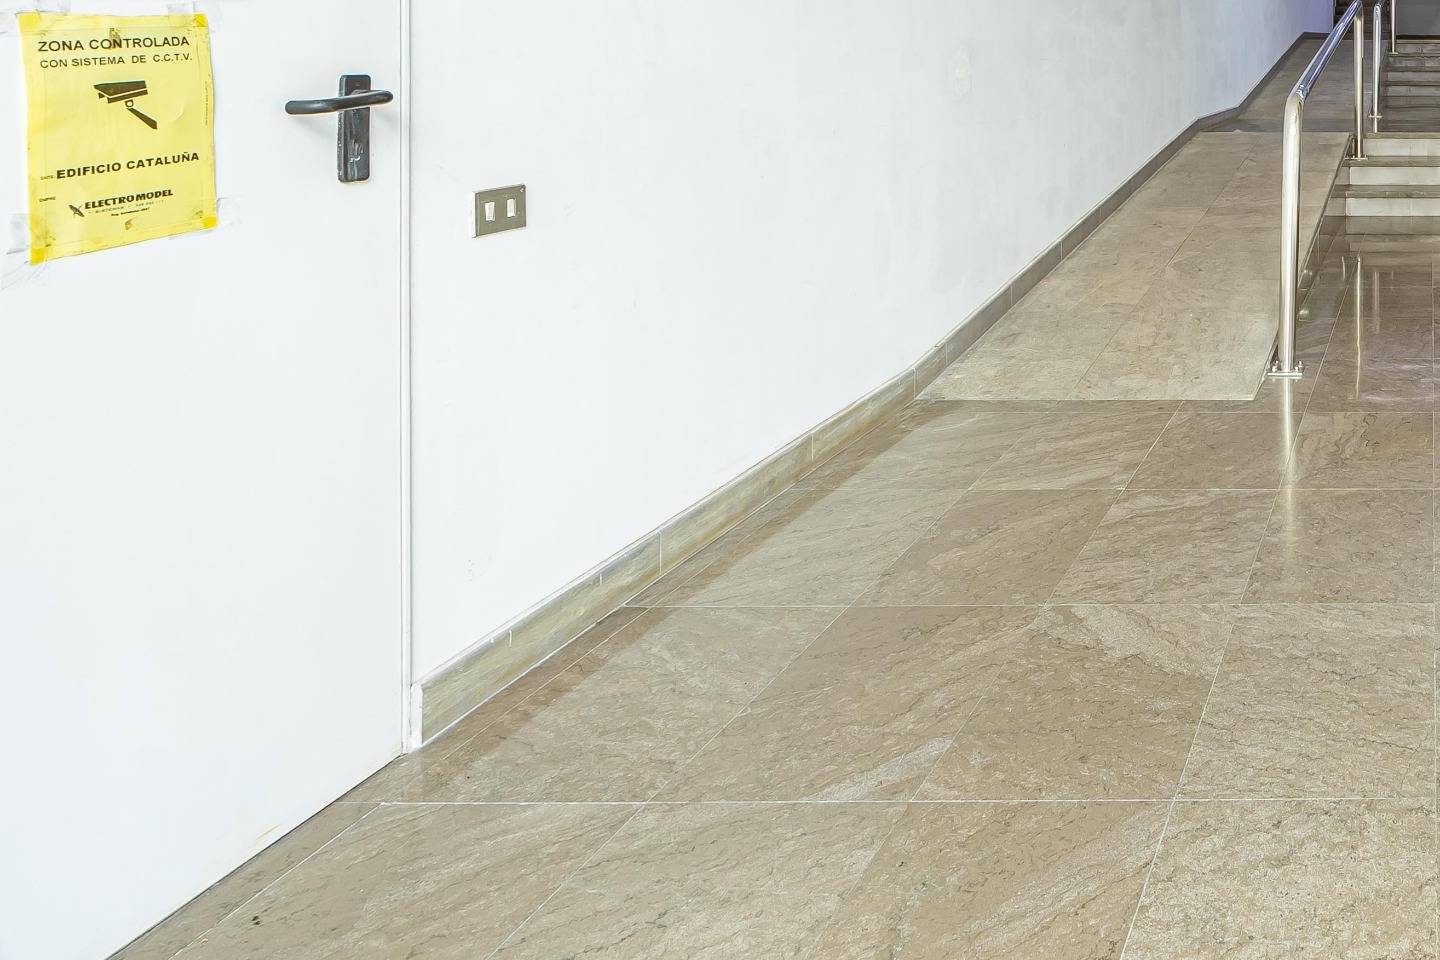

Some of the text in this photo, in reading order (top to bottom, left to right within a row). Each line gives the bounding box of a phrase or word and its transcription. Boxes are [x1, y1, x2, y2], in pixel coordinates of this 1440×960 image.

[37, 35, 190, 53] ZONA CONTROLADA
[39, 52, 193, 69] CON SISTEMA DE C.C.T.V.
[56, 151, 200, 180] EDIFICIO CATALUÑA
[84, 188, 174, 210] ELECTROMODEL
